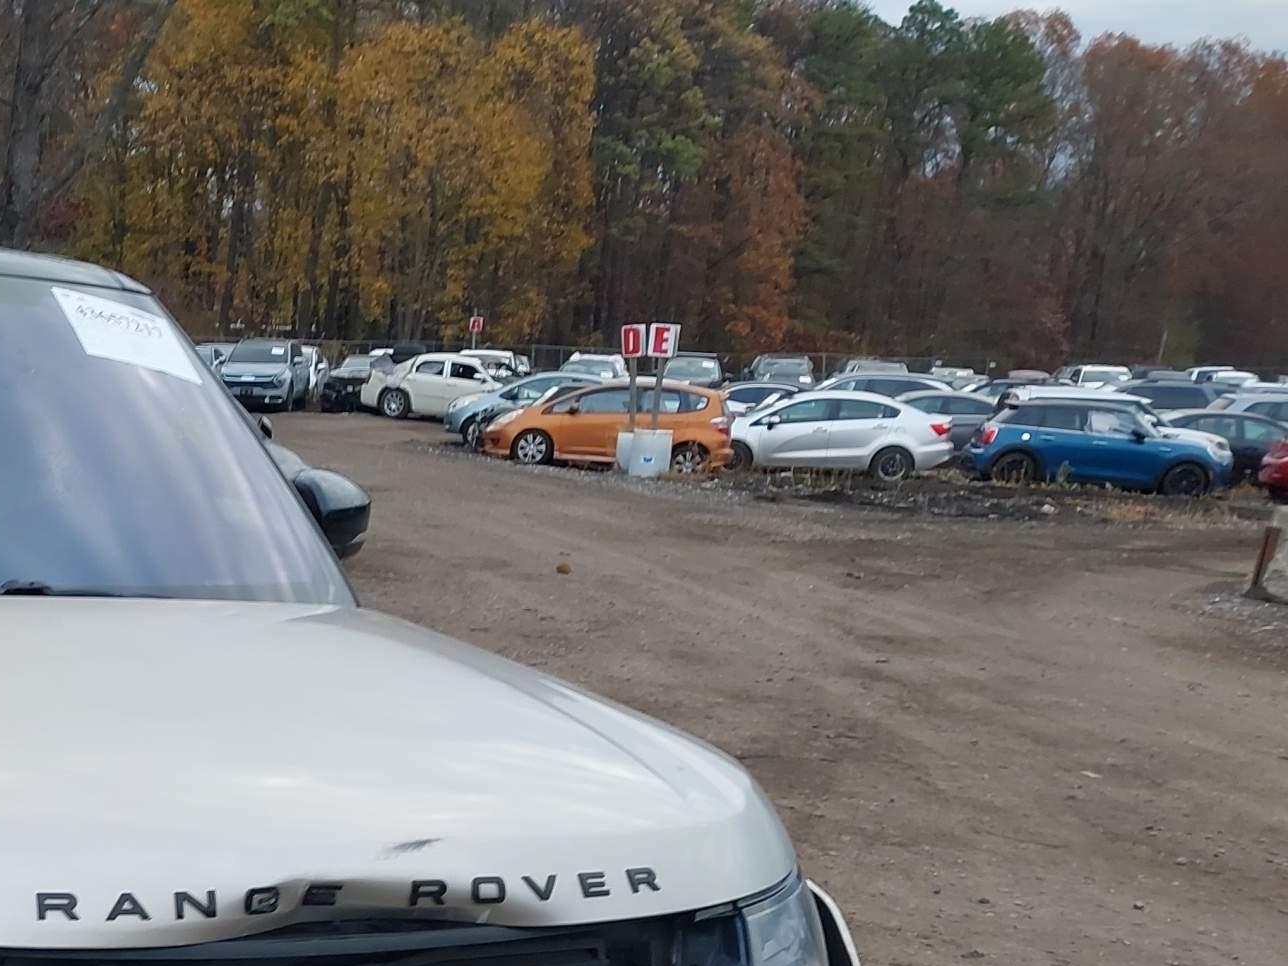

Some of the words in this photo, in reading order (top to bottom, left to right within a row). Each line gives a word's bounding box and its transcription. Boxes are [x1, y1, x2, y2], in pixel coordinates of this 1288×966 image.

[653, 326, 671, 354] E
[35, 883, 344, 922] RANGE
[408, 866, 661, 907] ROVER
